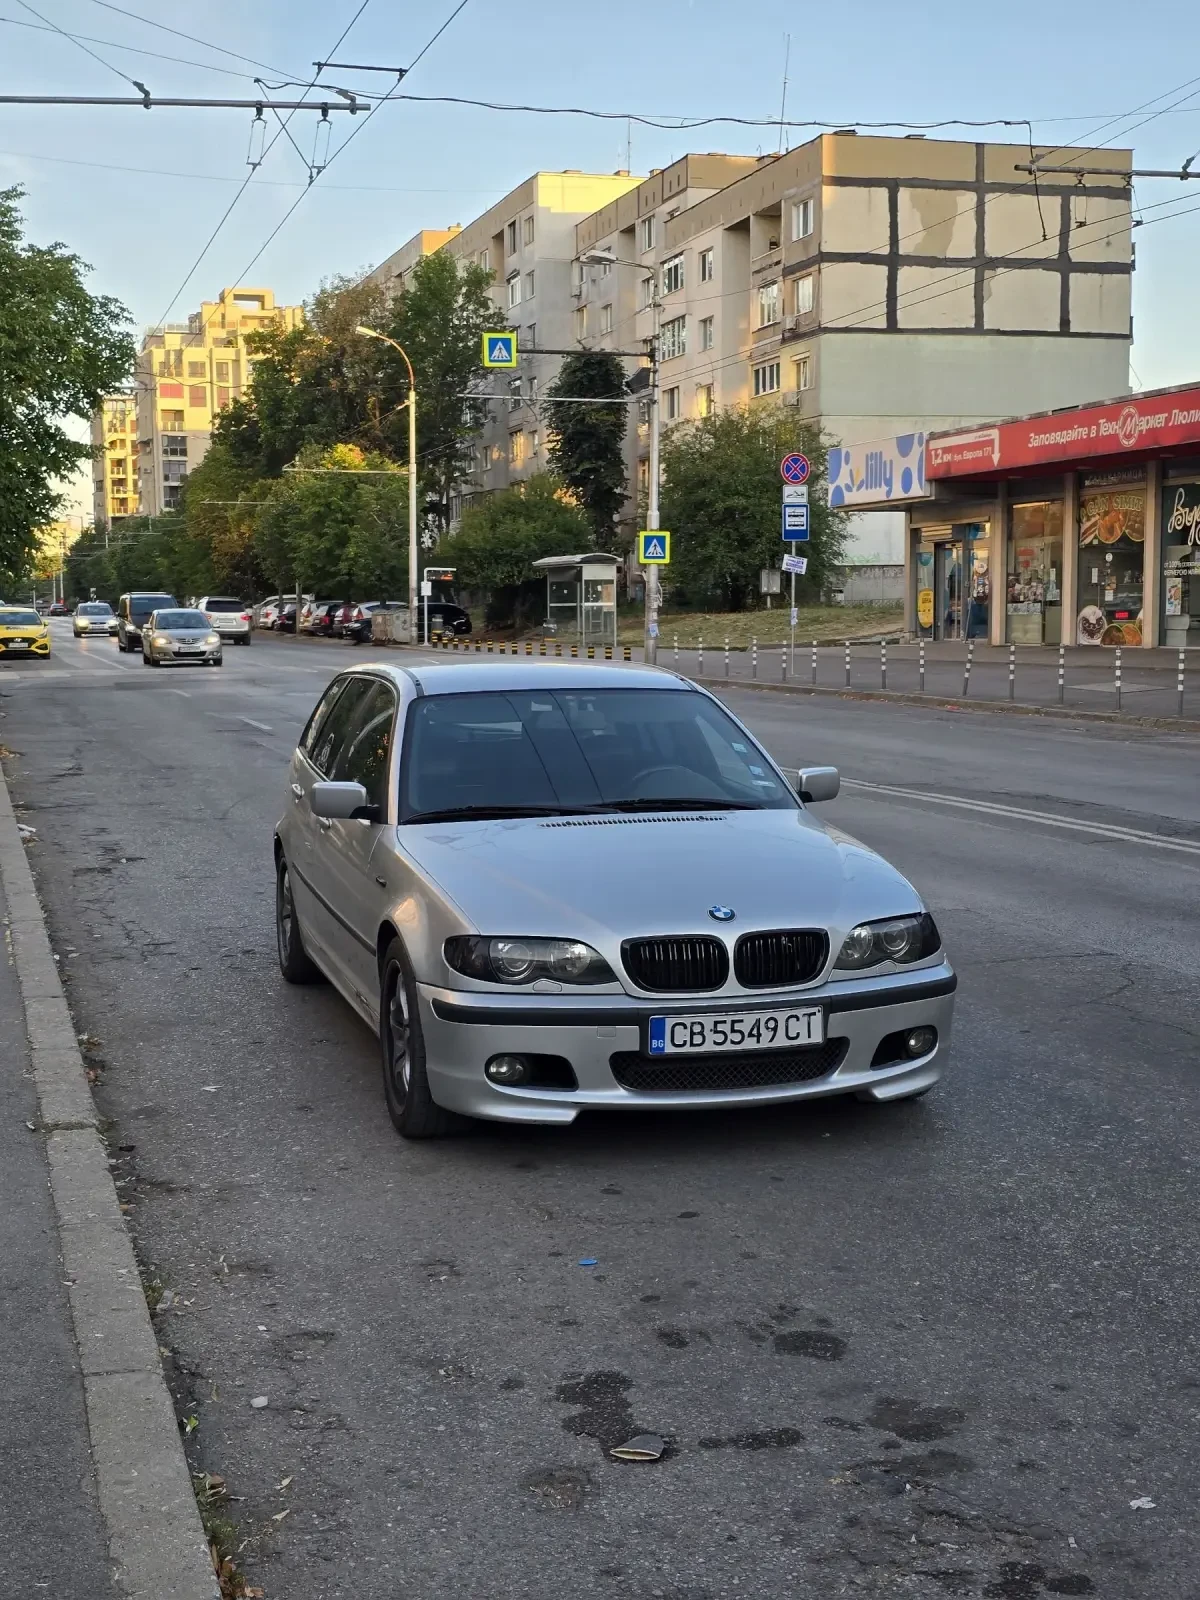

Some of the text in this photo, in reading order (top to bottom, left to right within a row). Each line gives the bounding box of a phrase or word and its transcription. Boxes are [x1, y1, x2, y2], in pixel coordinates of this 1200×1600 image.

[1028, 424, 1087, 448] Заповядайте
[1090, 426, 1097, 438] в
[865, 450, 893, 498] lilly
[652, 1039, 664, 1048] BG
